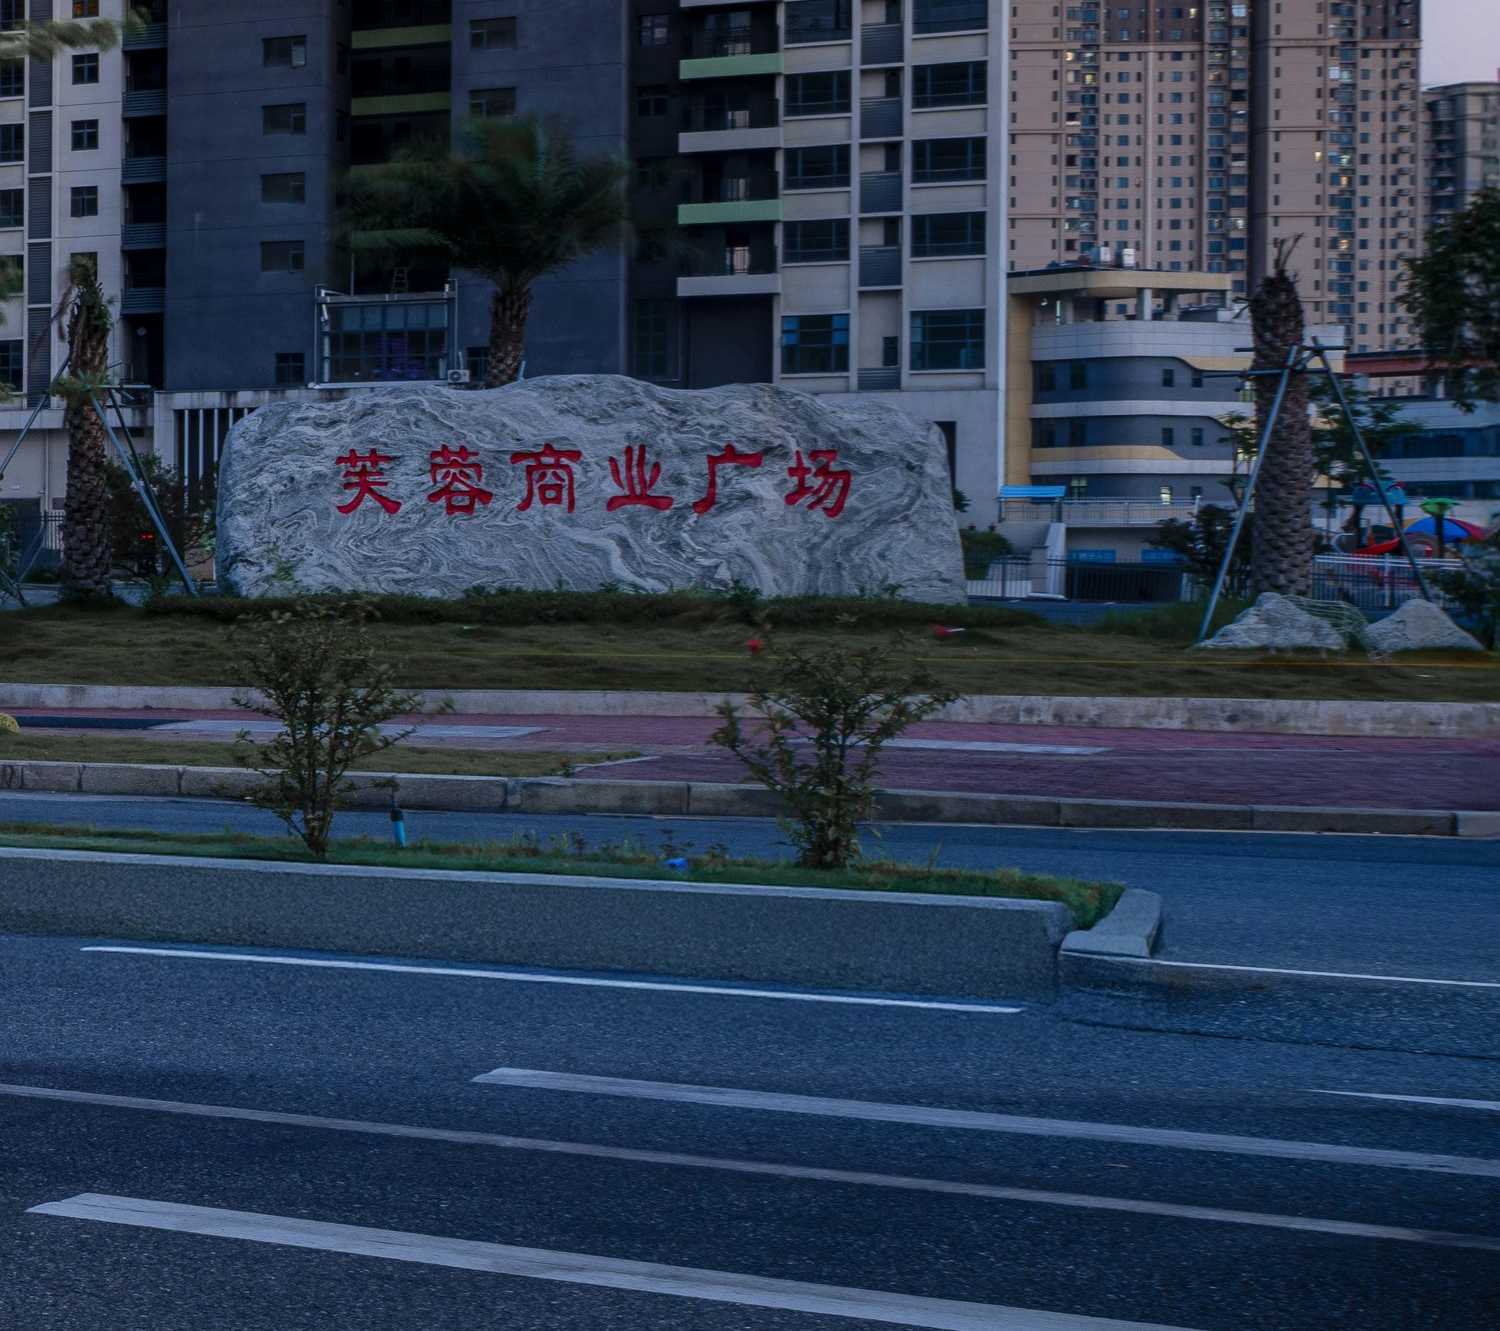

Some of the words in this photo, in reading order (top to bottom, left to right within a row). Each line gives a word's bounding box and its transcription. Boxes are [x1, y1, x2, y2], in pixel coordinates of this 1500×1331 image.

[336, 443, 852, 519] 芙蓉商业广场
